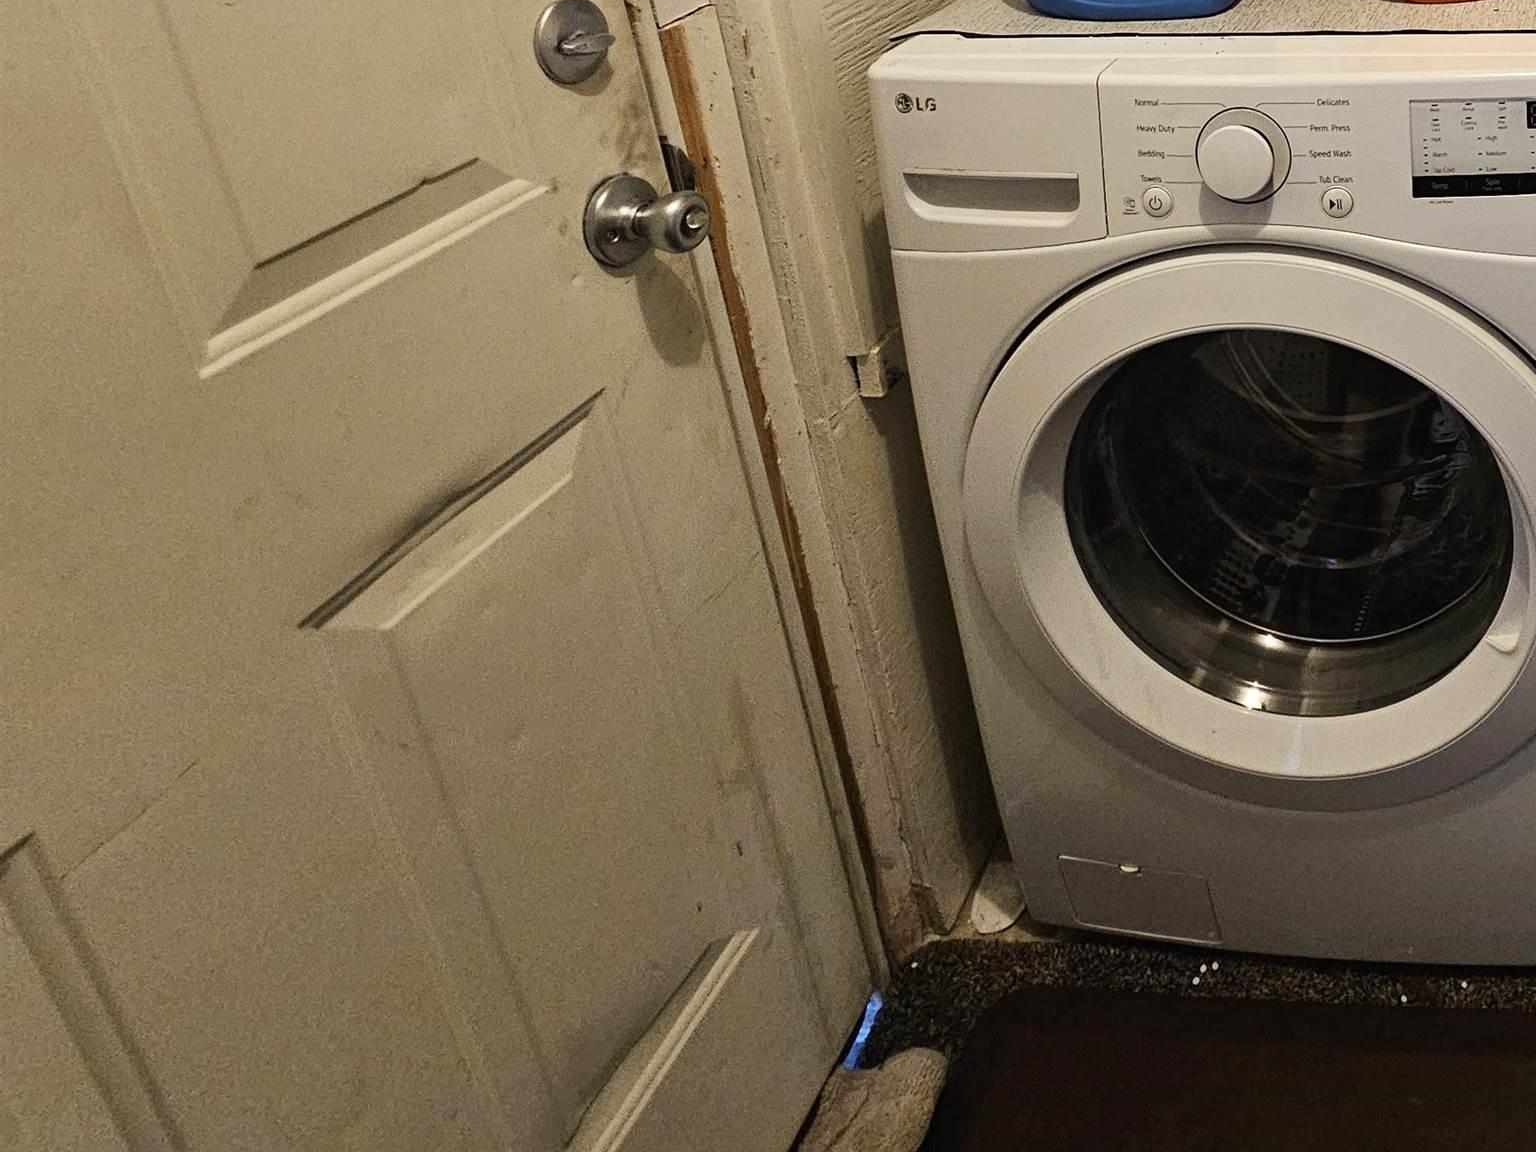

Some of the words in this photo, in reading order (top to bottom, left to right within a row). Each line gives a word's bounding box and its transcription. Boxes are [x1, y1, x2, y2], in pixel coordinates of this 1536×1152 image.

[915, 97, 937, 111] LG
[1136, 125, 1156, 133] Heavy
[1158, 125, 1175, 134] Duty
[1137, 150, 1165, 159] Bedding
[1308, 150, 1330, 159] Speed
[1332, 149, 1352, 157] Wash
[1140, 175, 1162, 183] Towels
